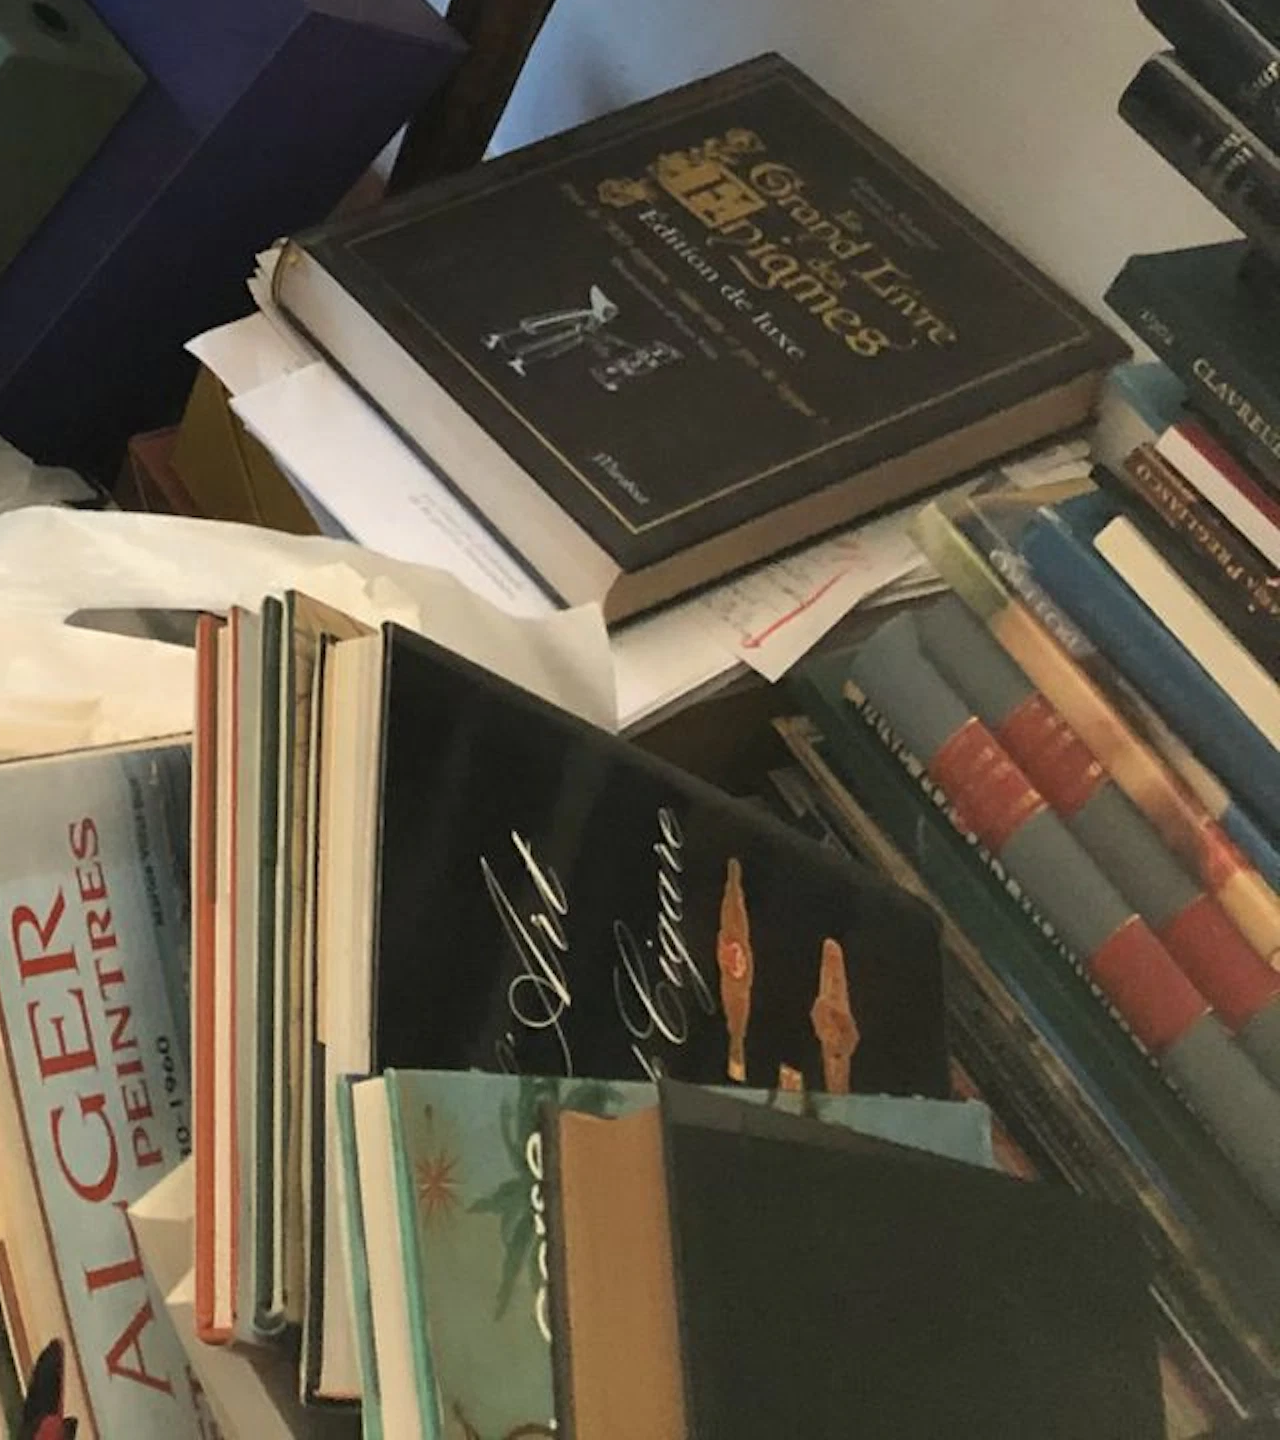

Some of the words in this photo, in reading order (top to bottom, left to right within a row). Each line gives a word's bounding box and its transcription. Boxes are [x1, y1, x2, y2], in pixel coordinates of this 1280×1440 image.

[753, 158, 879, 265] Grand
[857, 249, 957, 352] Livre
[753, 303, 808, 361] luxe
[69, 814, 165, 1168] PEINTRES
[482, 829, 573, 1079] 'Art
[614, 806, 715, 1050] Cigare
[11, 887, 176, 1396] ALGER
[154, 1034, 192, 1158] 30-1960
